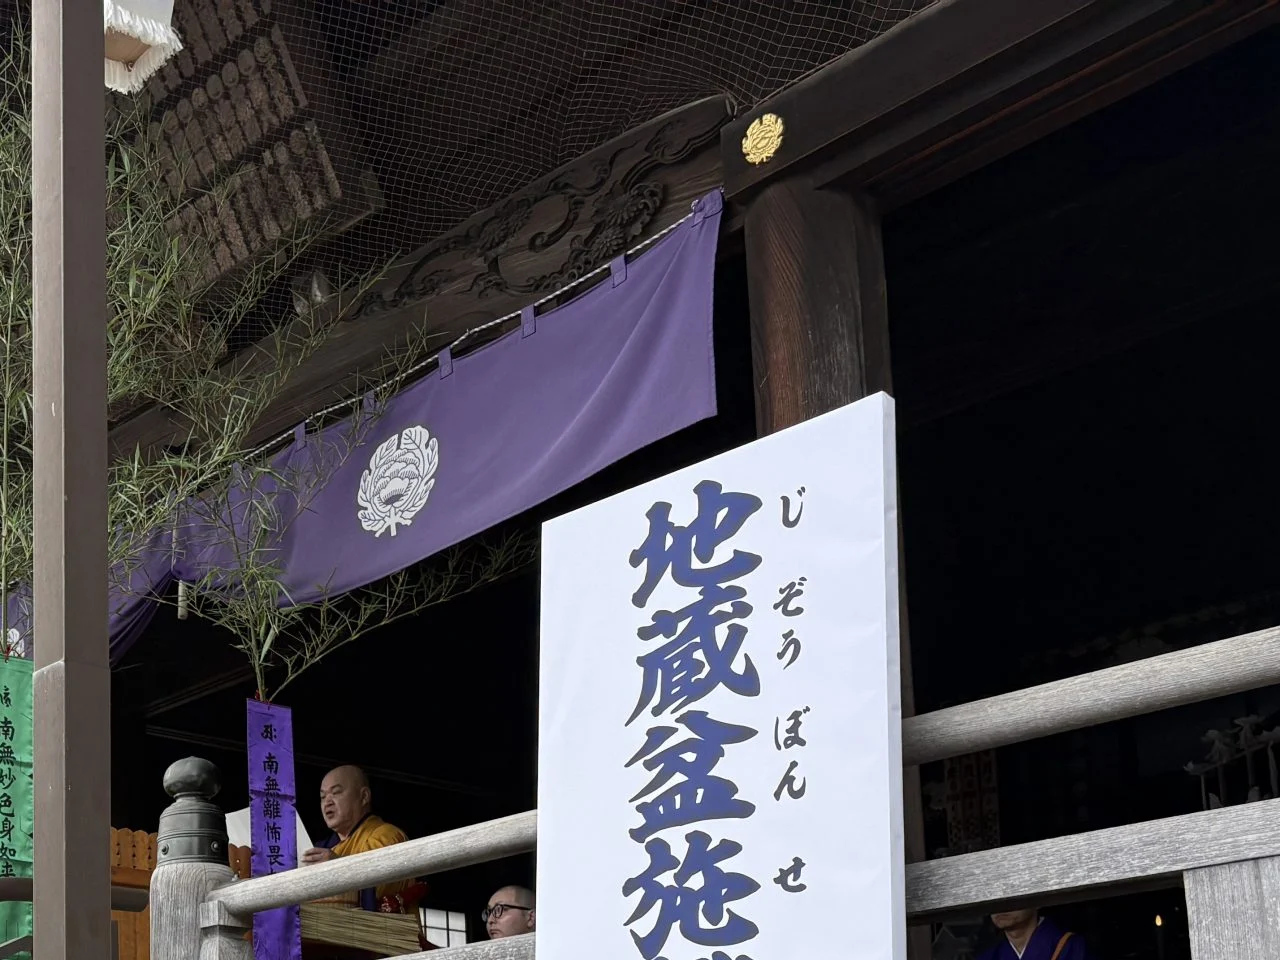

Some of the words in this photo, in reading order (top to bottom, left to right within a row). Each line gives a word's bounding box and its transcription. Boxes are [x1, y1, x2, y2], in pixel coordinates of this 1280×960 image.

[262, 752, 286, 874] 南無離怖畏
